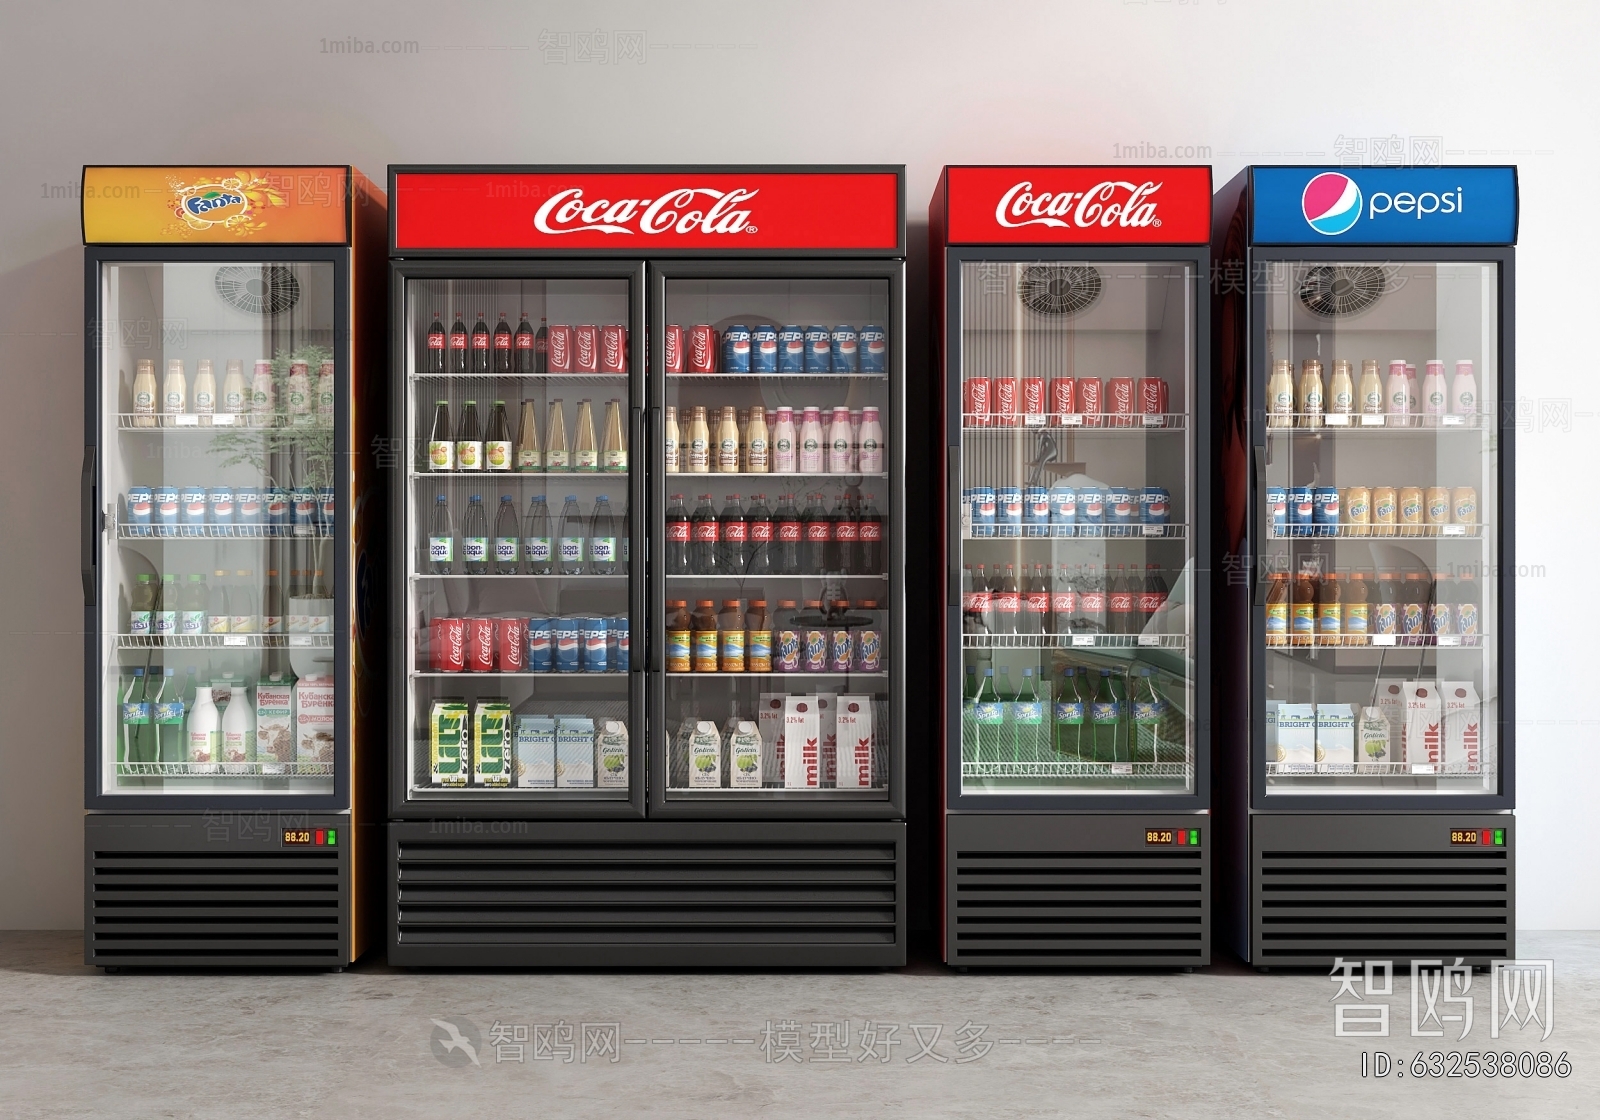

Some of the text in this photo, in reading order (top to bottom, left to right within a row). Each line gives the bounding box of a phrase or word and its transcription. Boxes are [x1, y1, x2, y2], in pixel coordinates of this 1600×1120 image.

[187, 194, 244, 215] Fanta
[1369, 186, 1463, 219] pepsi
[803, 737, 818, 786] milk
[855, 737, 870, 786] milk
[284, 832, 308, 842] 88.20
[1146, 832, 1172, 842] 88.20
[1452, 832, 1476, 842] 88.20
